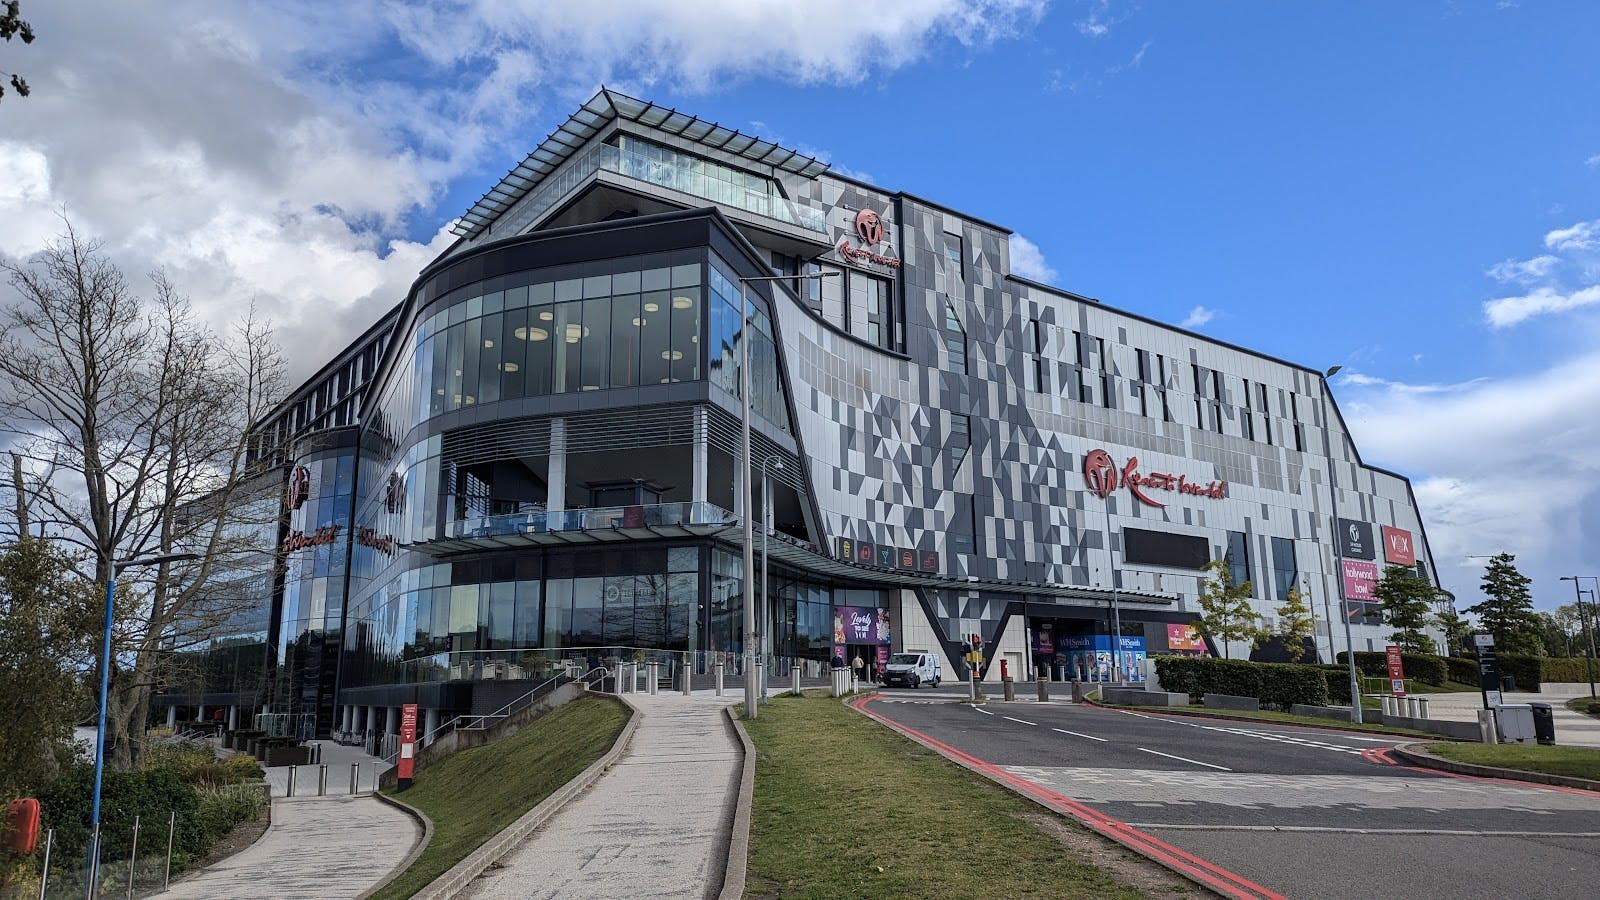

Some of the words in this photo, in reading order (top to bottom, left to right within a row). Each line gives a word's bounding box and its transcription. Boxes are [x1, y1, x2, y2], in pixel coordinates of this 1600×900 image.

[1120, 456, 1177, 508] Resorts
[1390, 534, 1409, 553] VOX
[1345, 565, 1373, 580] hollywood
[1354, 582, 1368, 594] bowl
[850, 611, 871, 627] Lovely
[1060, 638, 1090, 647] WHSmith
